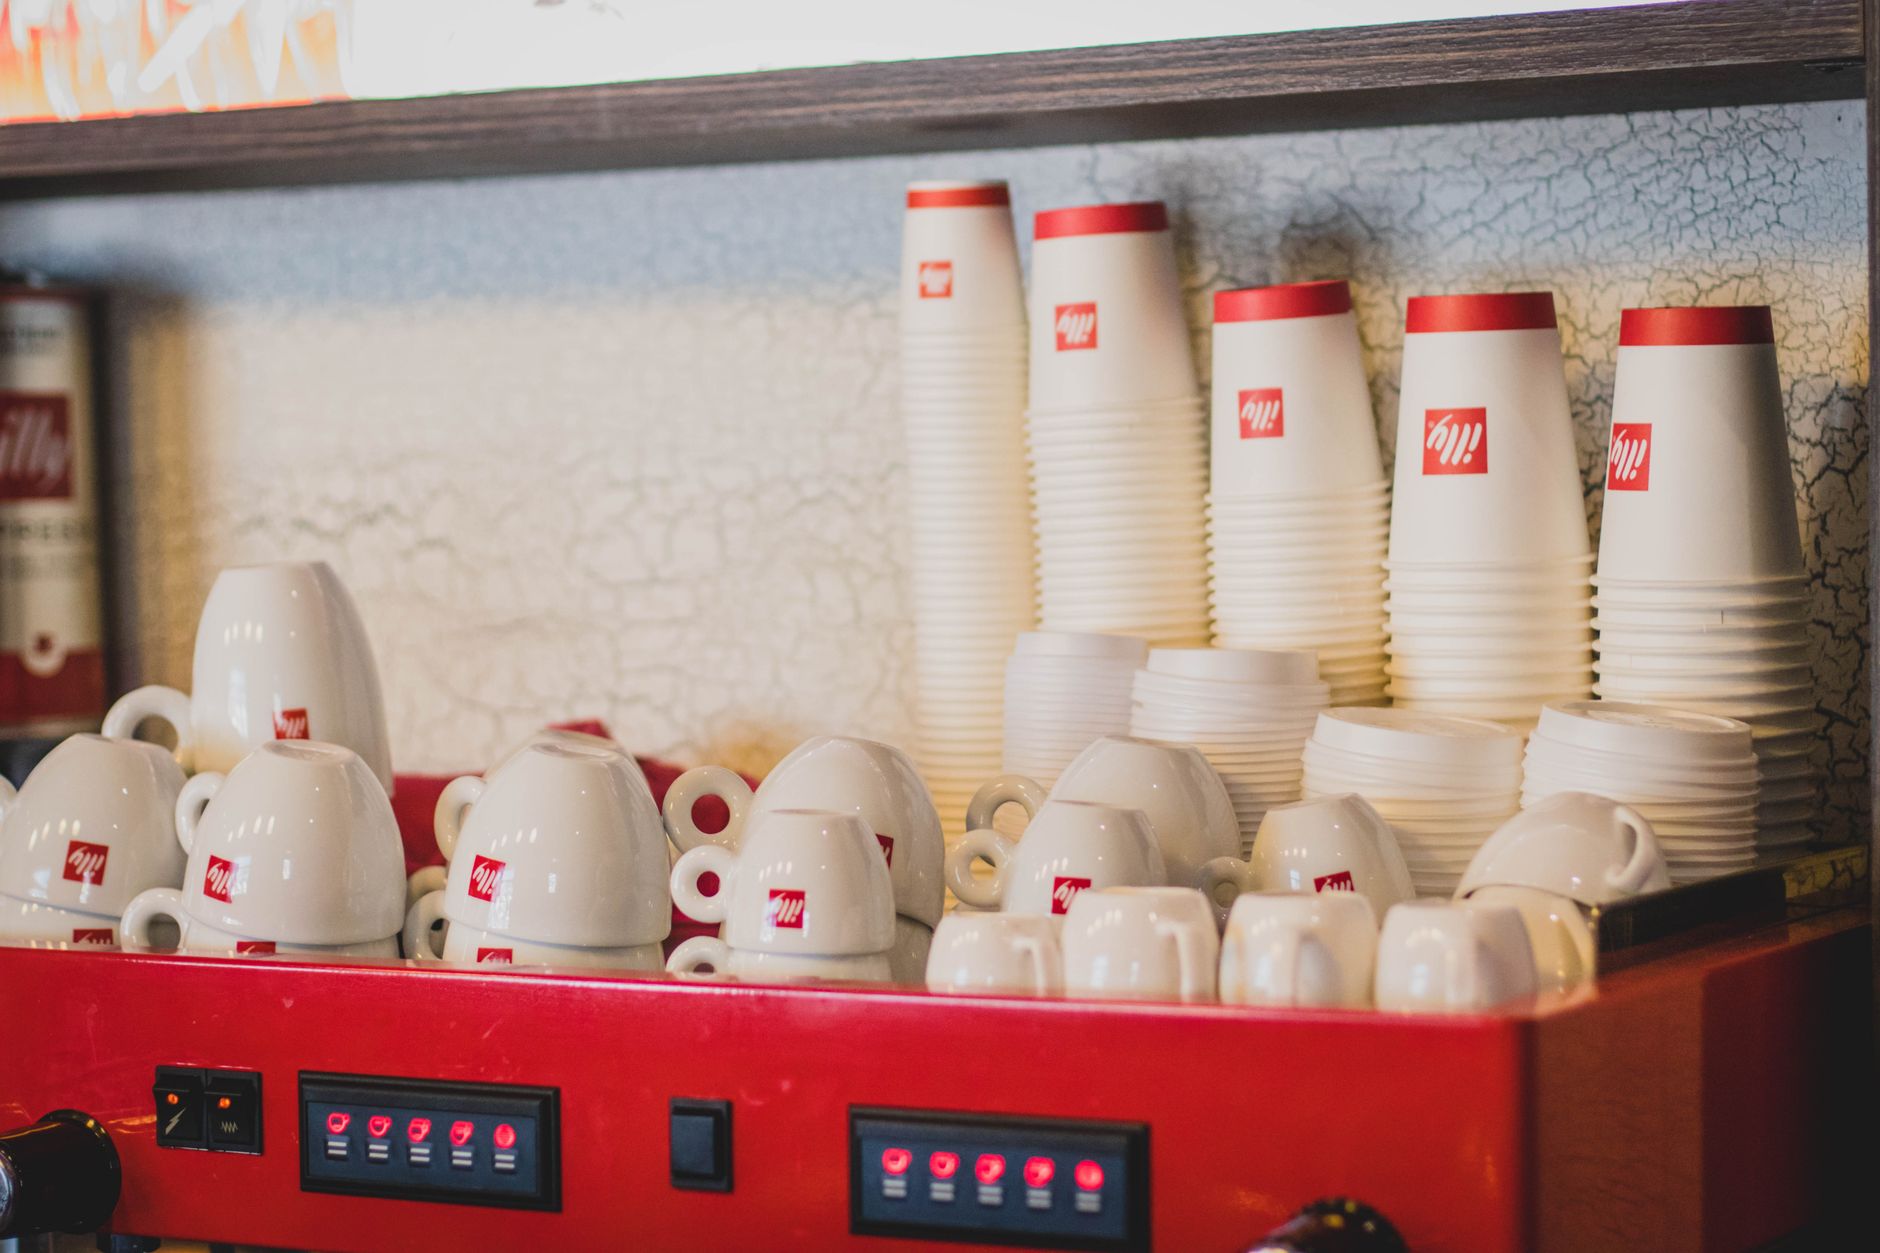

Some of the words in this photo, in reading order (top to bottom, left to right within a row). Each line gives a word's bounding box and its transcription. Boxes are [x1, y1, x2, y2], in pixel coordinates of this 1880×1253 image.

[1241, 394, 1280, 431] illy
[1427, 414, 1482, 465] illy
[1611, 429, 1647, 481] illy
[68, 846, 105, 877] illy
